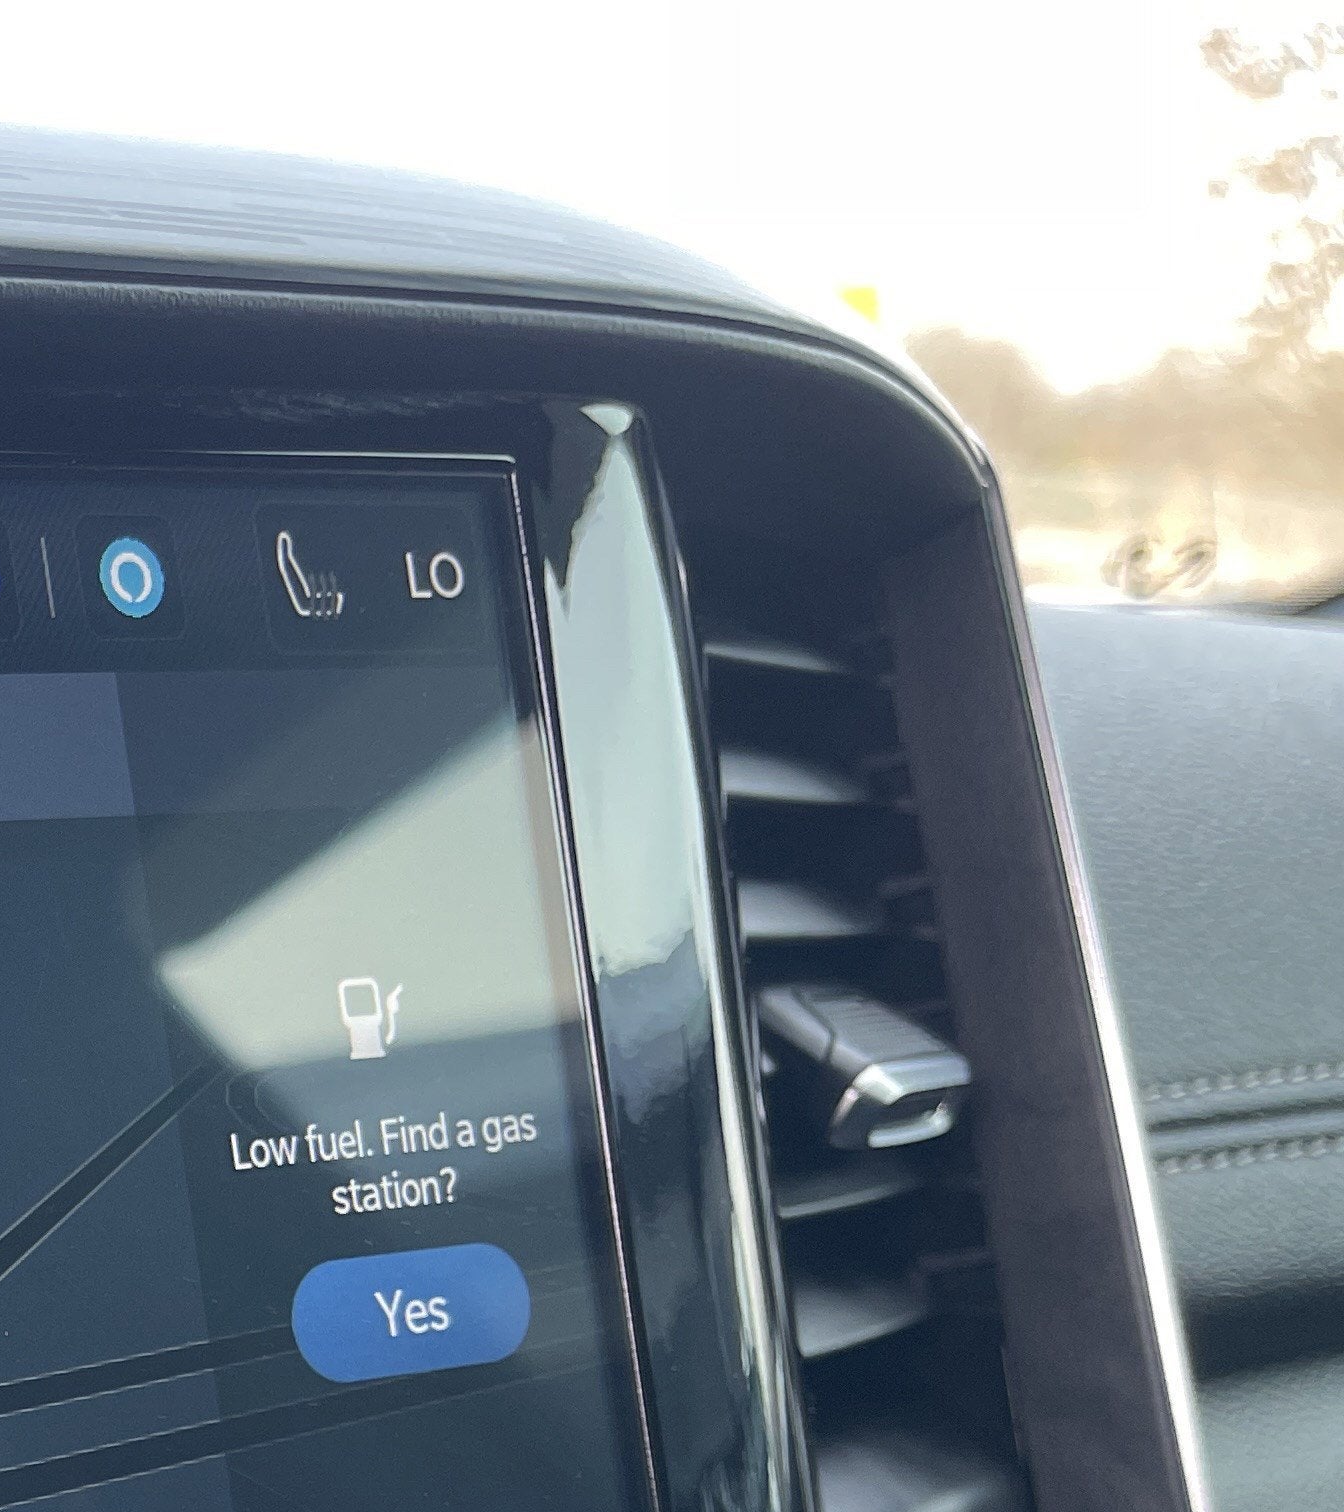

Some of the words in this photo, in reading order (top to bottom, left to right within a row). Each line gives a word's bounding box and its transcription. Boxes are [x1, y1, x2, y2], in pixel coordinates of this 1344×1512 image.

[405, 551, 465, 599] LO
[230, 1132, 298, 1171] Low
[304, 1119, 374, 1163] fuel.
[380, 1111, 449, 1156] Find
[455, 1120, 477, 1149] a
[481, 1112, 538, 1153] gas
[331, 1166, 458, 1215] station?
[373, 1289, 451, 1338] Yes
